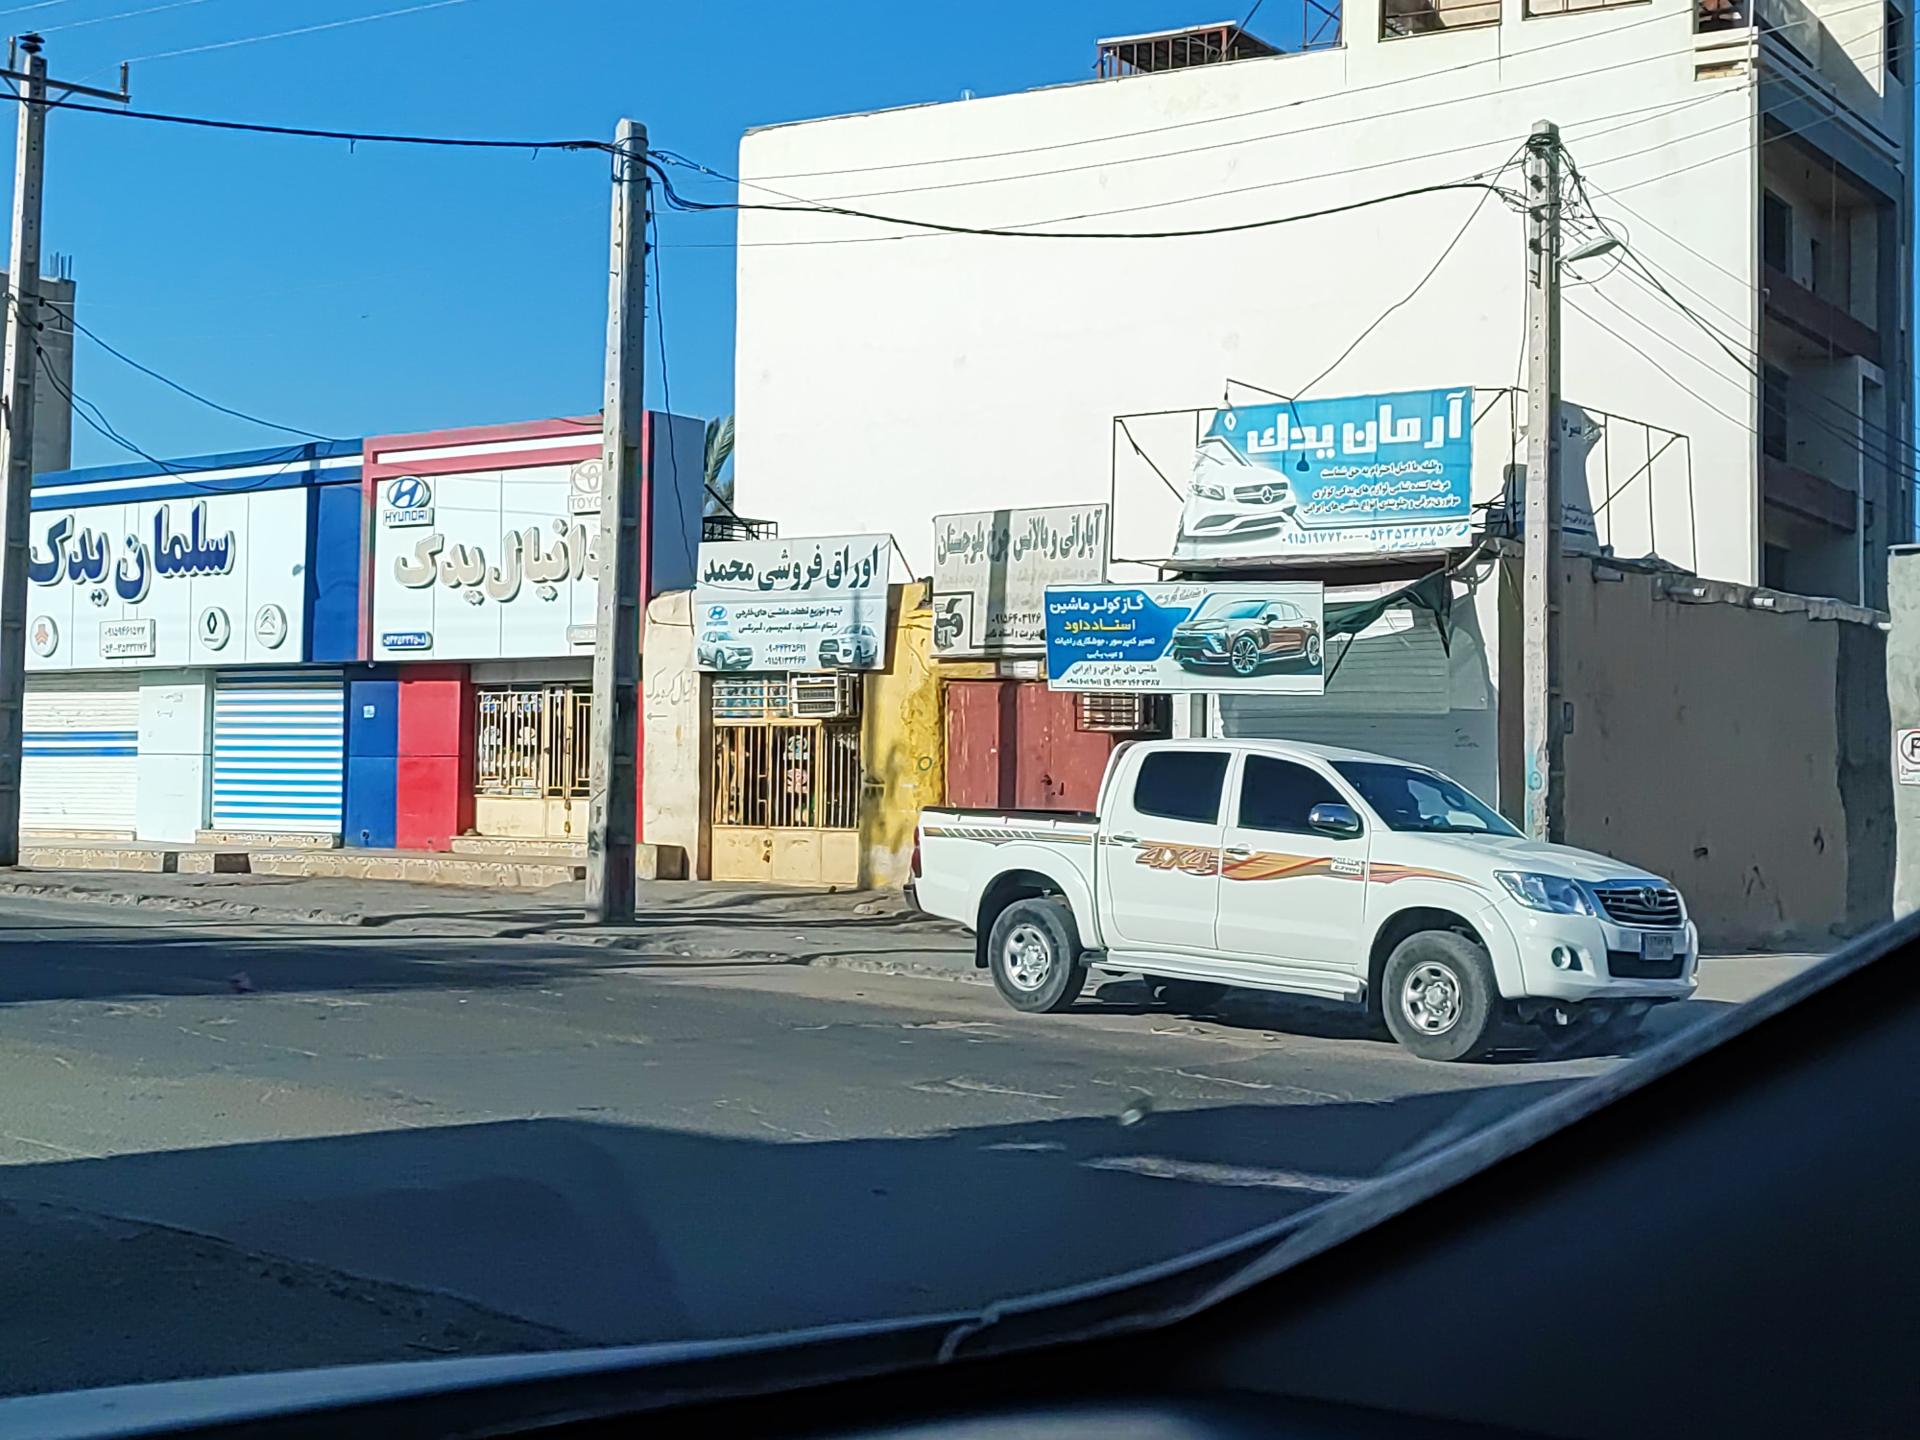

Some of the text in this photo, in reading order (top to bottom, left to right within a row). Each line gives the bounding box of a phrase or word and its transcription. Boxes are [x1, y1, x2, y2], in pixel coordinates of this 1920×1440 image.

[1246, 391, 1465, 460] آرمان یدک
[571, 494, 601, 510] TOYO
[385, 509, 428, 523] HYUNDAI
[28, 500, 236, 608] سلمان یدک
[393, 534, 486, 606] یدک
[703, 543, 879, 592] اوراق فروشی محمد
[1049, 596, 1090, 615] ماشین
[1090, 596, 1121, 615] کولر
[1121, 593, 1145, 614] گاز
[1063, 618, 1136, 635] استاد داود
[1098, 665, 1121, 676] خارجی
[1136, 846, 1212, 870] 4X4
